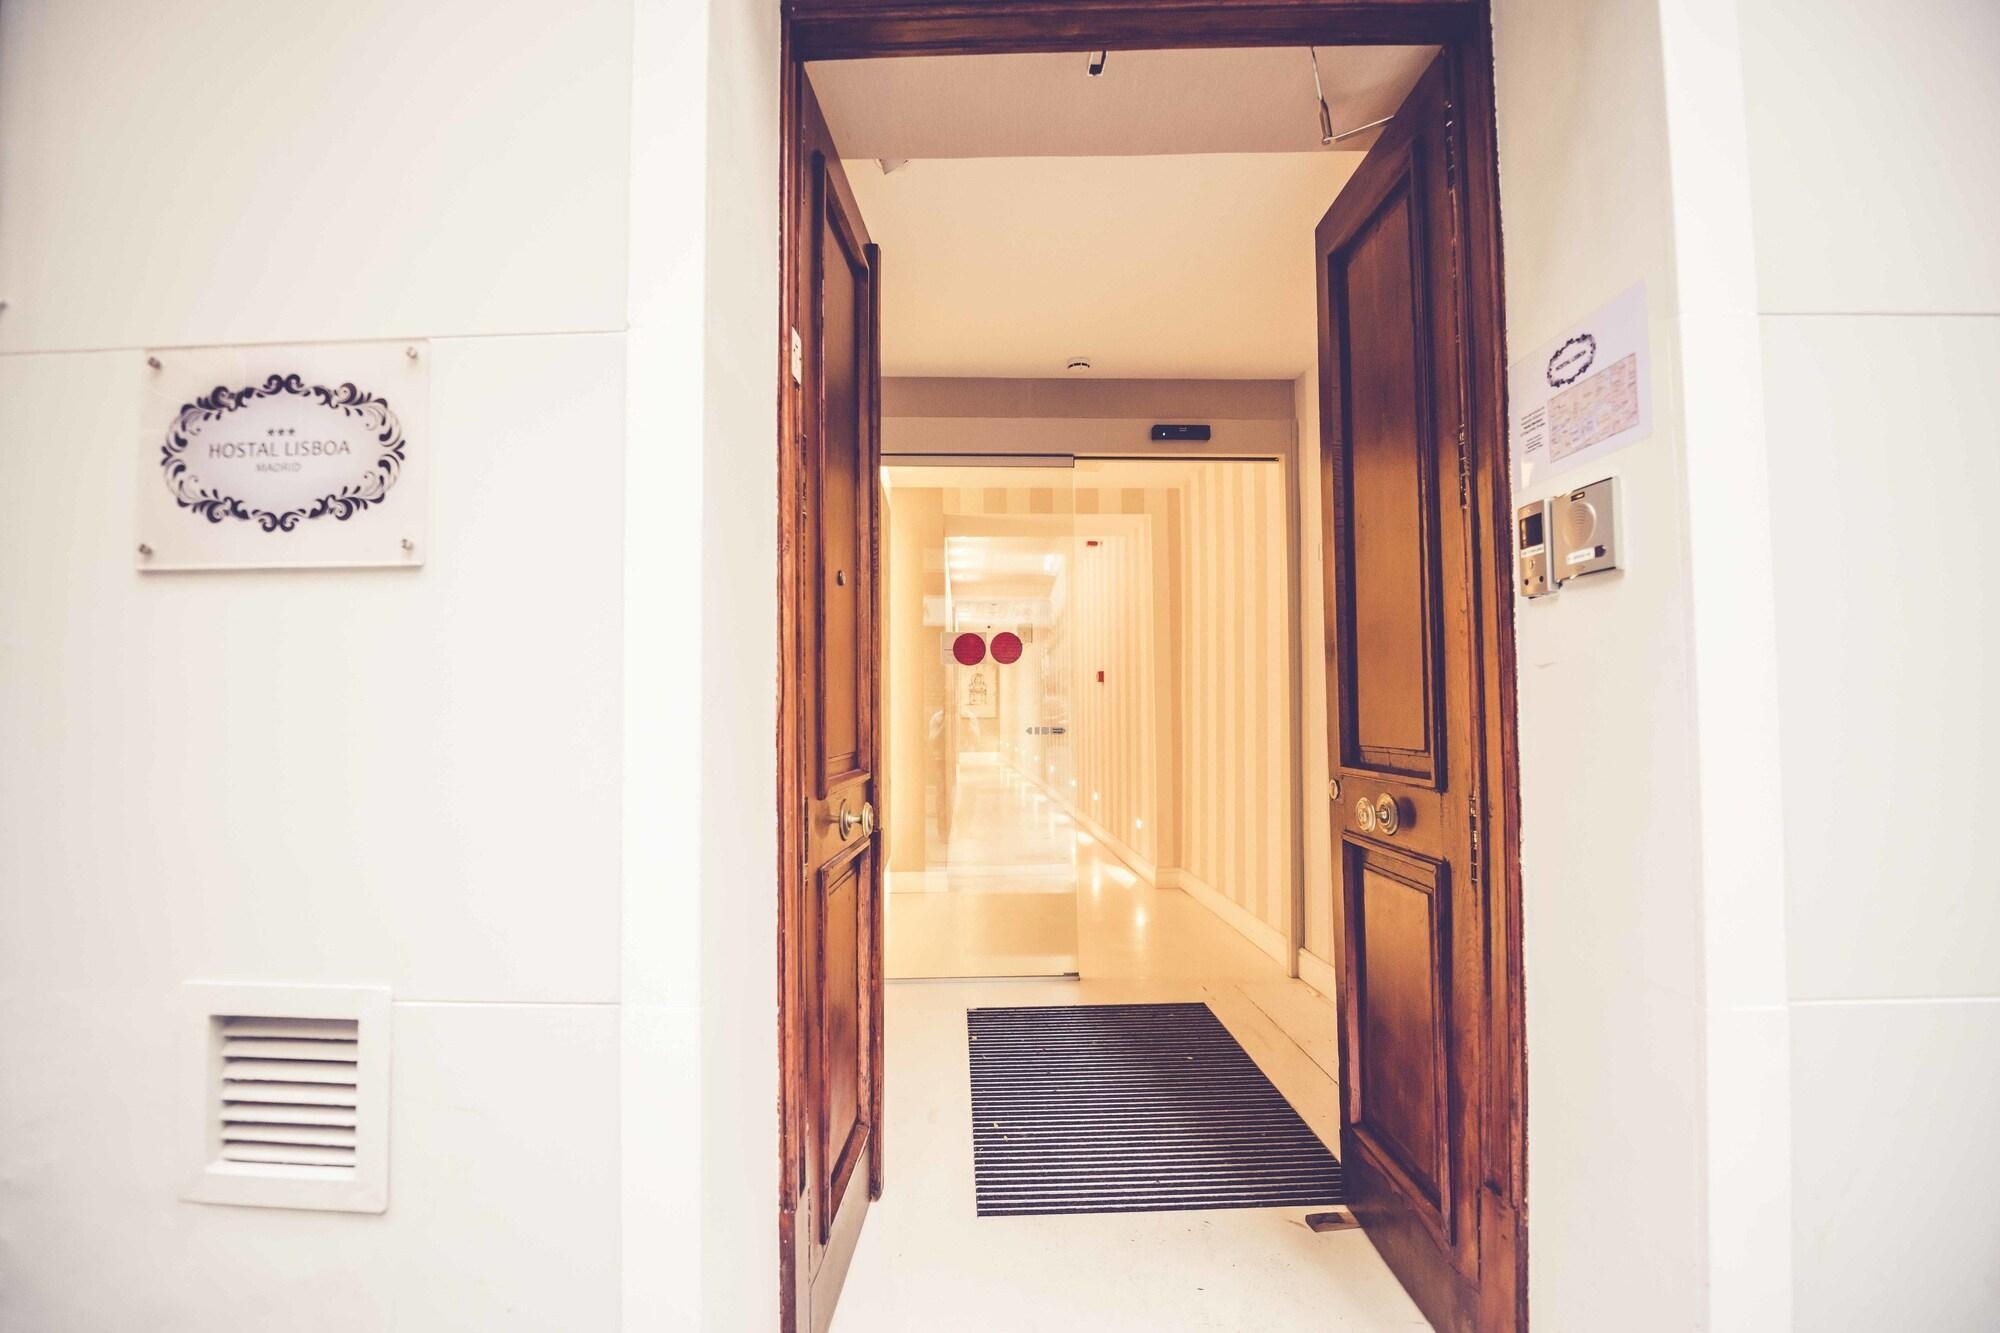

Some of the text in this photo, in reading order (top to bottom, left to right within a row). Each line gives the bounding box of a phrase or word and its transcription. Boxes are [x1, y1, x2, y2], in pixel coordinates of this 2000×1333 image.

[208, 439, 351, 458] HOSTAL LISBOA
[256, 461, 302, 473] MADRID
